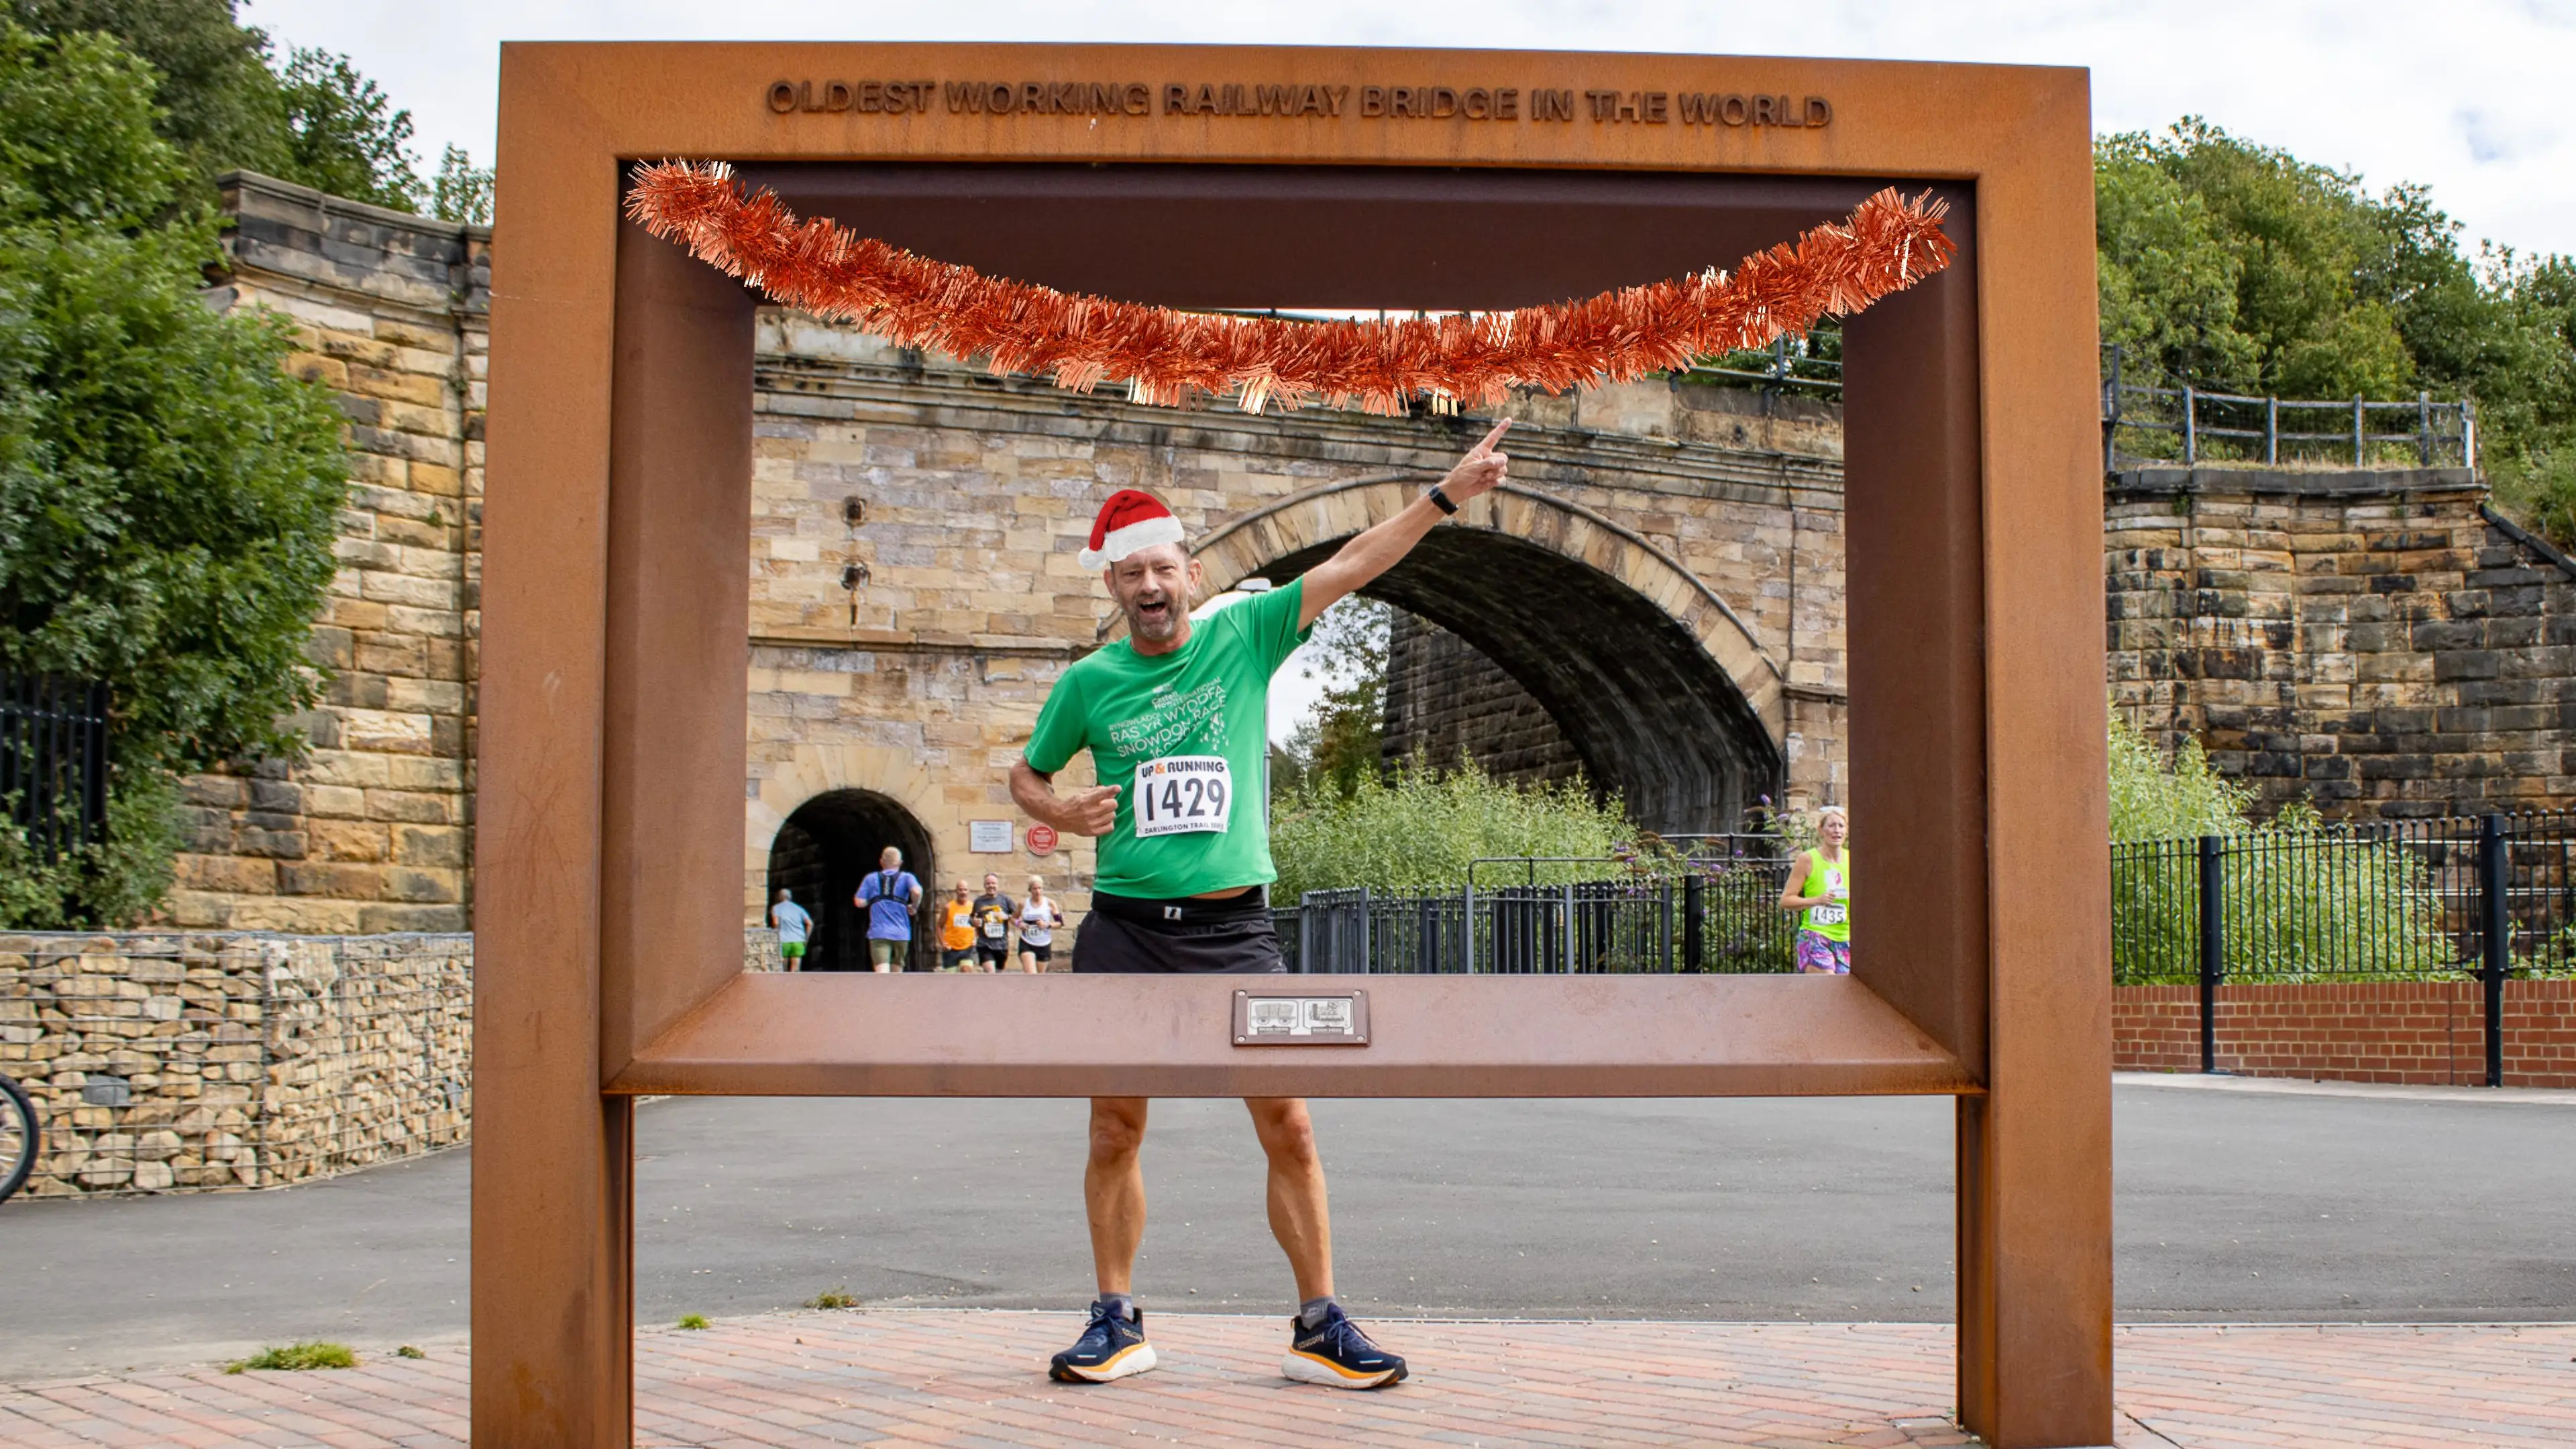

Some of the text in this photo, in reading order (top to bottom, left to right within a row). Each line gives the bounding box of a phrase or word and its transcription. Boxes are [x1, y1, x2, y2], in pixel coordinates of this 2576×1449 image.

[768, 80, 1833, 128] OLDEST WORKING RAILWAY BRIDGE IN THE WORLD
[1110, 685, 1226, 744] RAS YR WYDDFA
[1117, 695, 1226, 758] SNOWDON RACE
[1142, 761, 1225, 777] UP & RUNNING
[1146, 777, 1225, 822] 1429
[1815, 908, 1843, 923] 1435
